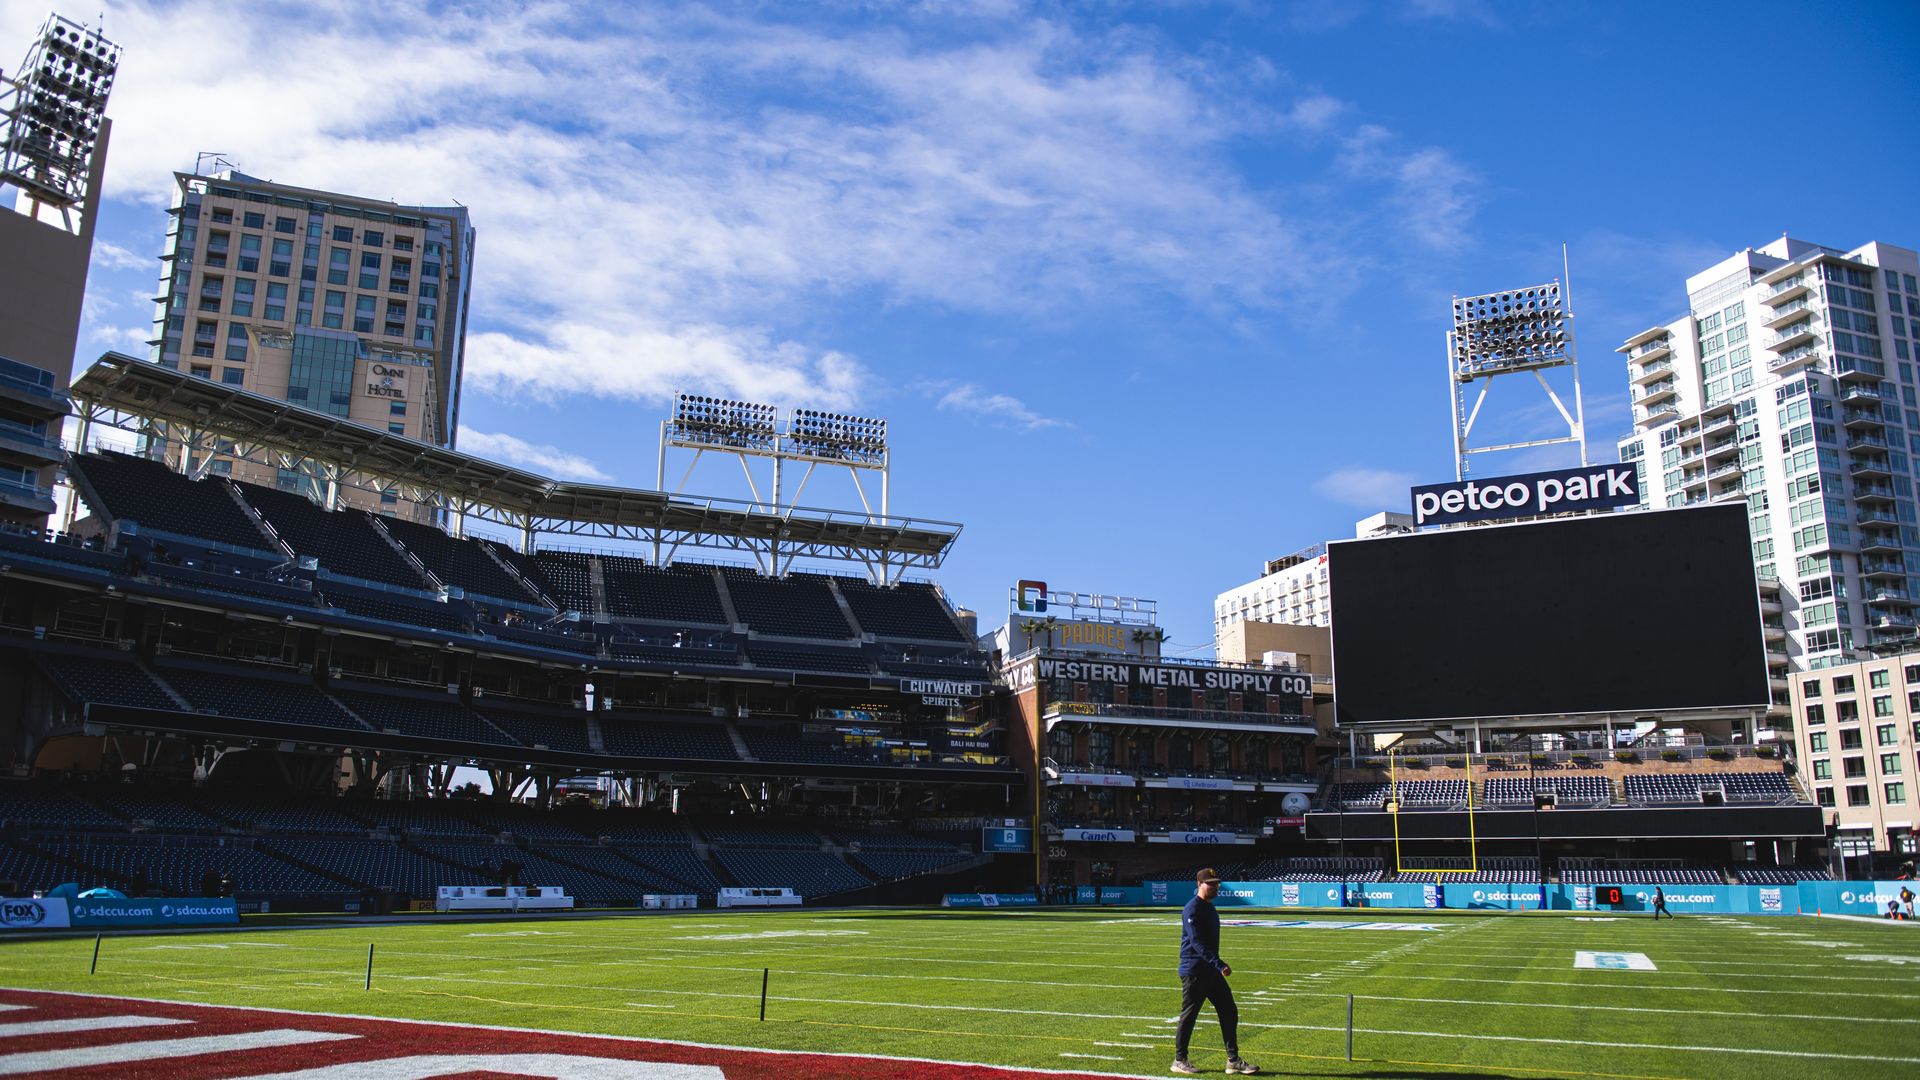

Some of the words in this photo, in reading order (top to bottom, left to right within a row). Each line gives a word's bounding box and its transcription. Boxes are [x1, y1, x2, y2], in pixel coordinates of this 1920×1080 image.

[367, 383, 405, 398] HOTEL
[1415, 481, 1530, 524] petco
[1537, 468, 1635, 512] park
[1052, 590, 1147, 612] QUIDEL
[1062, 623, 1126, 651] PADRES
[1038, 659, 1129, 682] WESTERN
[1139, 667, 1200, 688] METAL
[1205, 671, 1273, 692] SUPPLY
[1281, 677, 1310, 695] CO.
[910, 680, 972, 696] CUTWATER
[922, 696, 960, 707] SPIRITS
[1080, 831, 1117, 841] Canel's
[1184, 833, 1219, 843] Canel's
[1048, 846, 1067, 858] 336
[1217, 889, 1254, 898] ccu.com
[1346, 889, 1393, 900] dccu.com
[1609, 889, 1619, 903] 0
[1651, 892, 1715, 905] sccu.com
[4, 904, 35, 917] FOX
[90, 905, 153, 917] sdccu.com
[176, 905, 234, 916] sdccu.com
